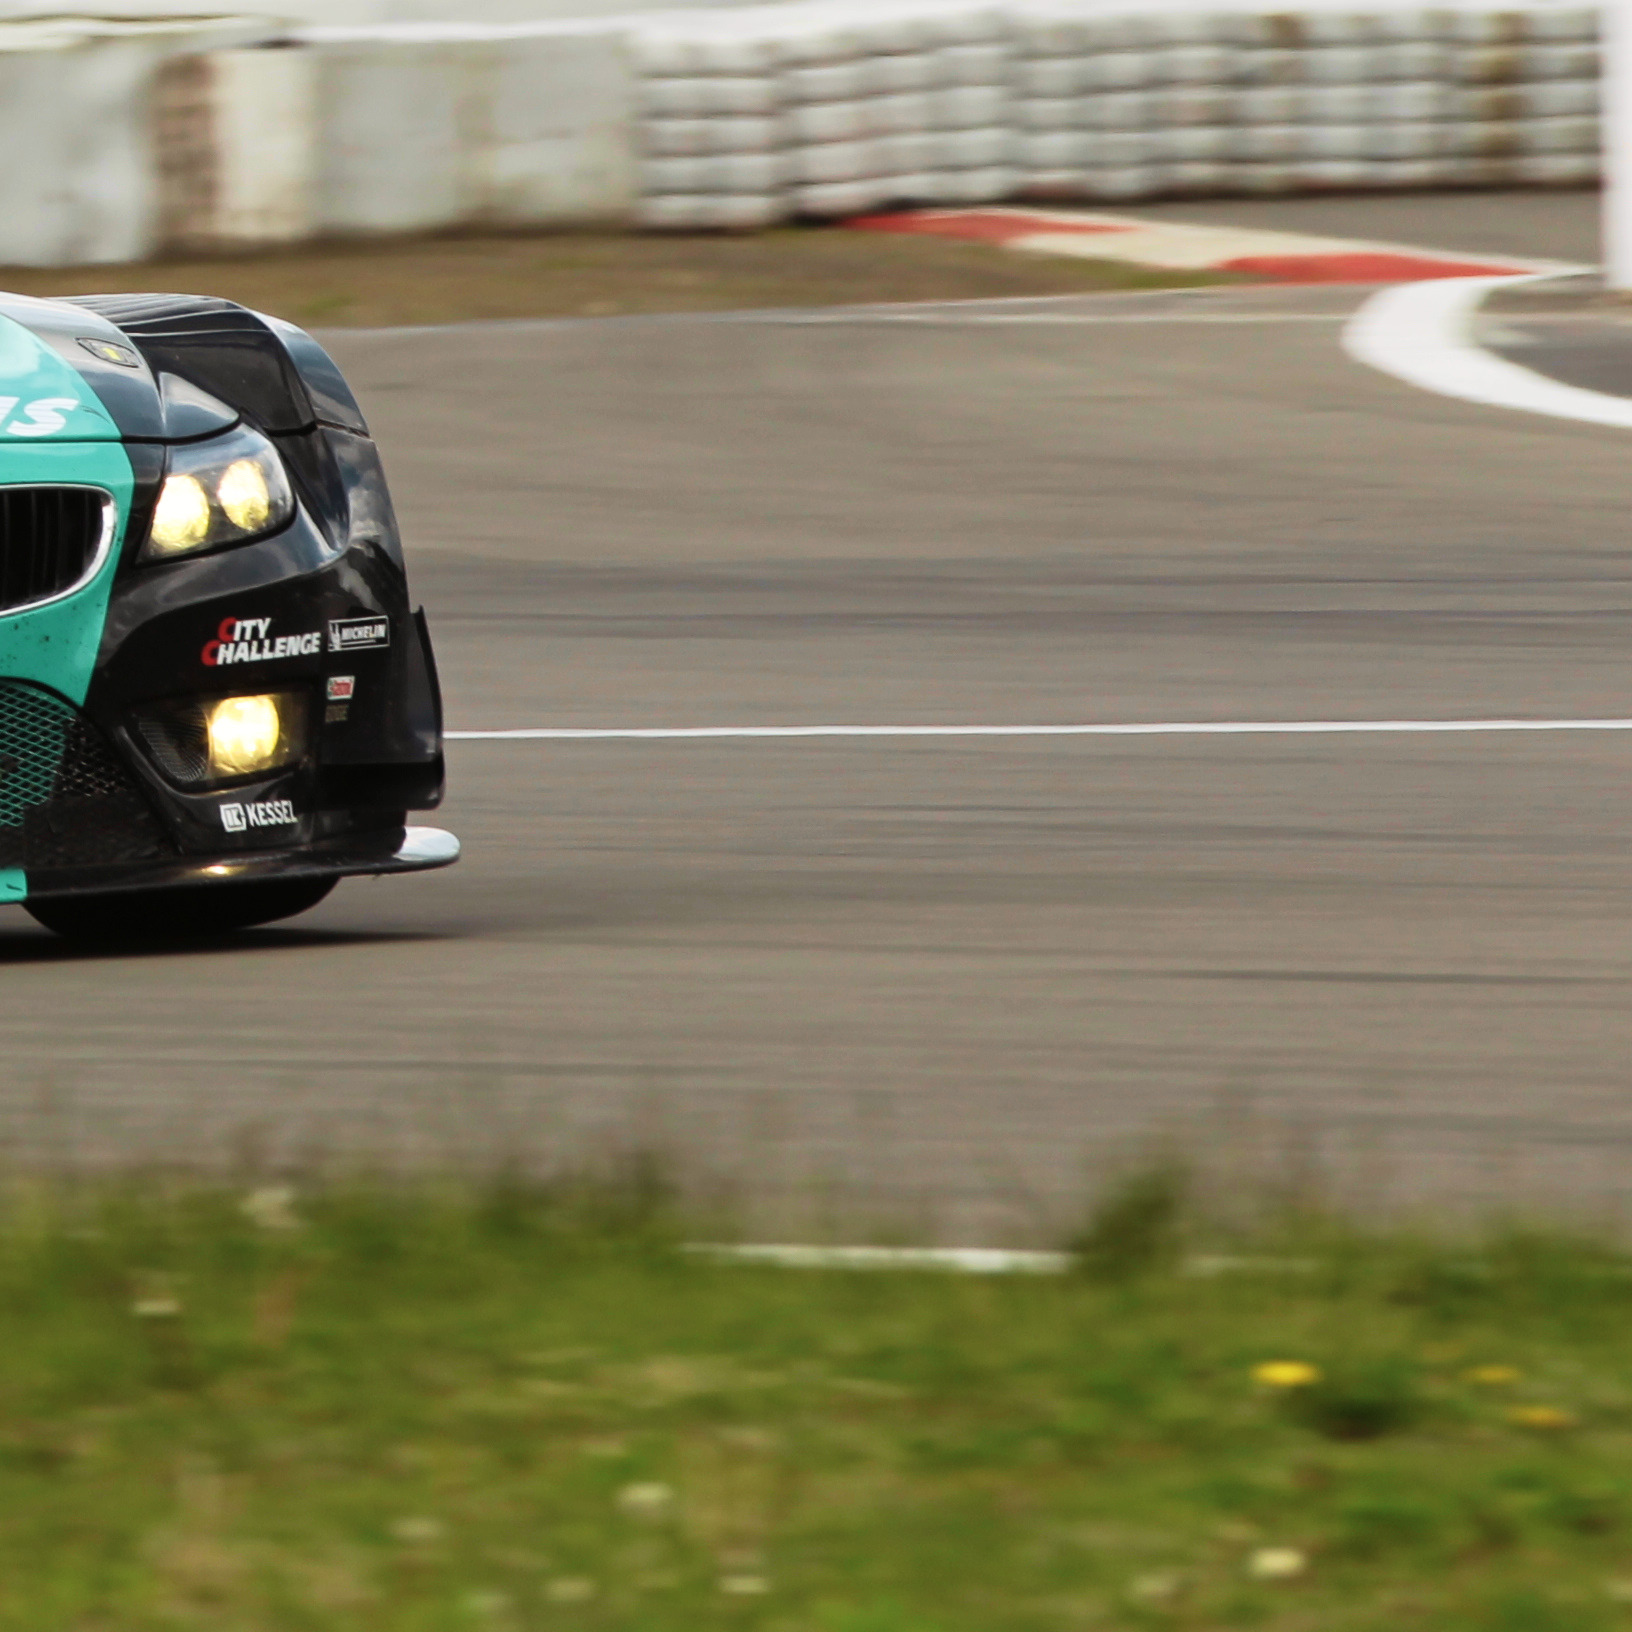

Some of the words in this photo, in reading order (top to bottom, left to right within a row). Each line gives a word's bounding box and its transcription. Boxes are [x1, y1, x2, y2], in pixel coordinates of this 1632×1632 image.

[218, 616, 272, 643] CITY
[340, 623, 387, 641] MICHELIN
[201, 631, 322, 667] CHALLENGE
[244, 799, 298, 827] KESSEL
